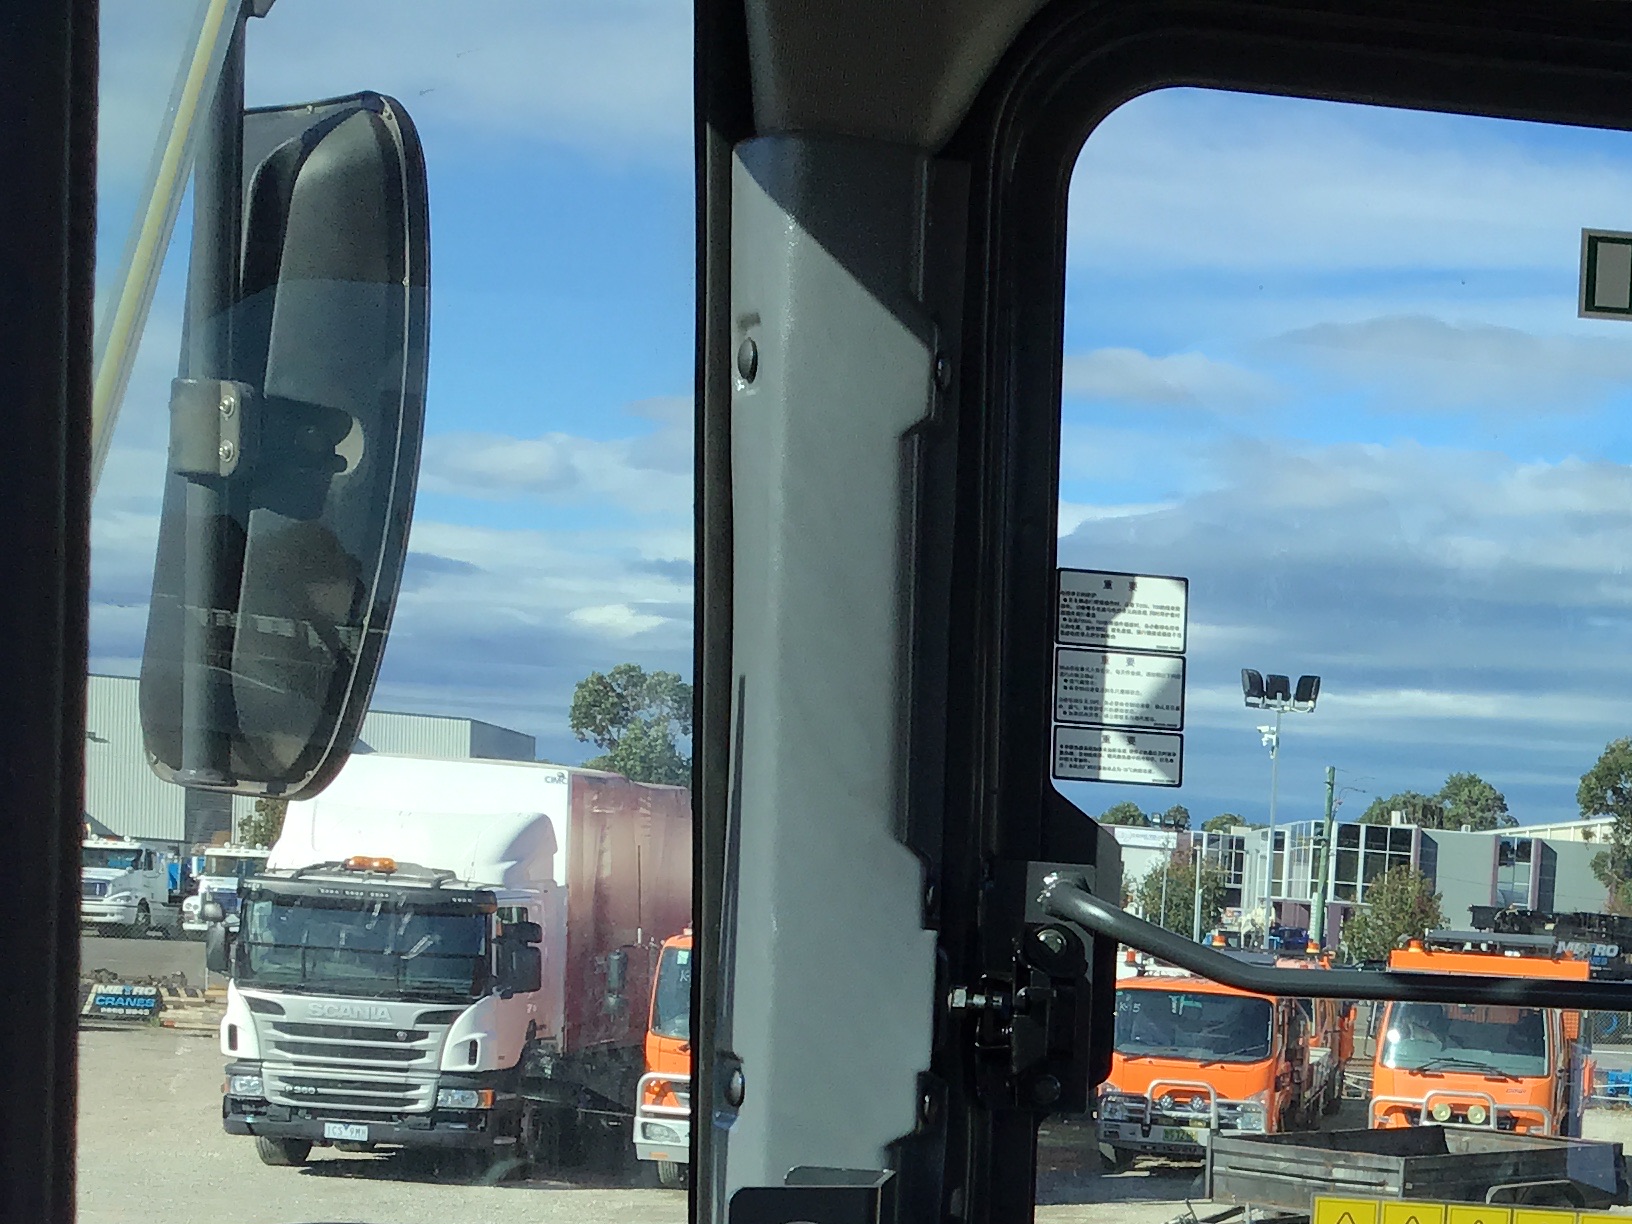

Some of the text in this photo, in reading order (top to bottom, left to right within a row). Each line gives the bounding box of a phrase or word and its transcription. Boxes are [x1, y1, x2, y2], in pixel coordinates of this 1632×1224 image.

[97, 984, 157, 995] METRO
[95, 996, 156, 1007] CRANES
[307, 1002, 392, 1021] SCANIA
